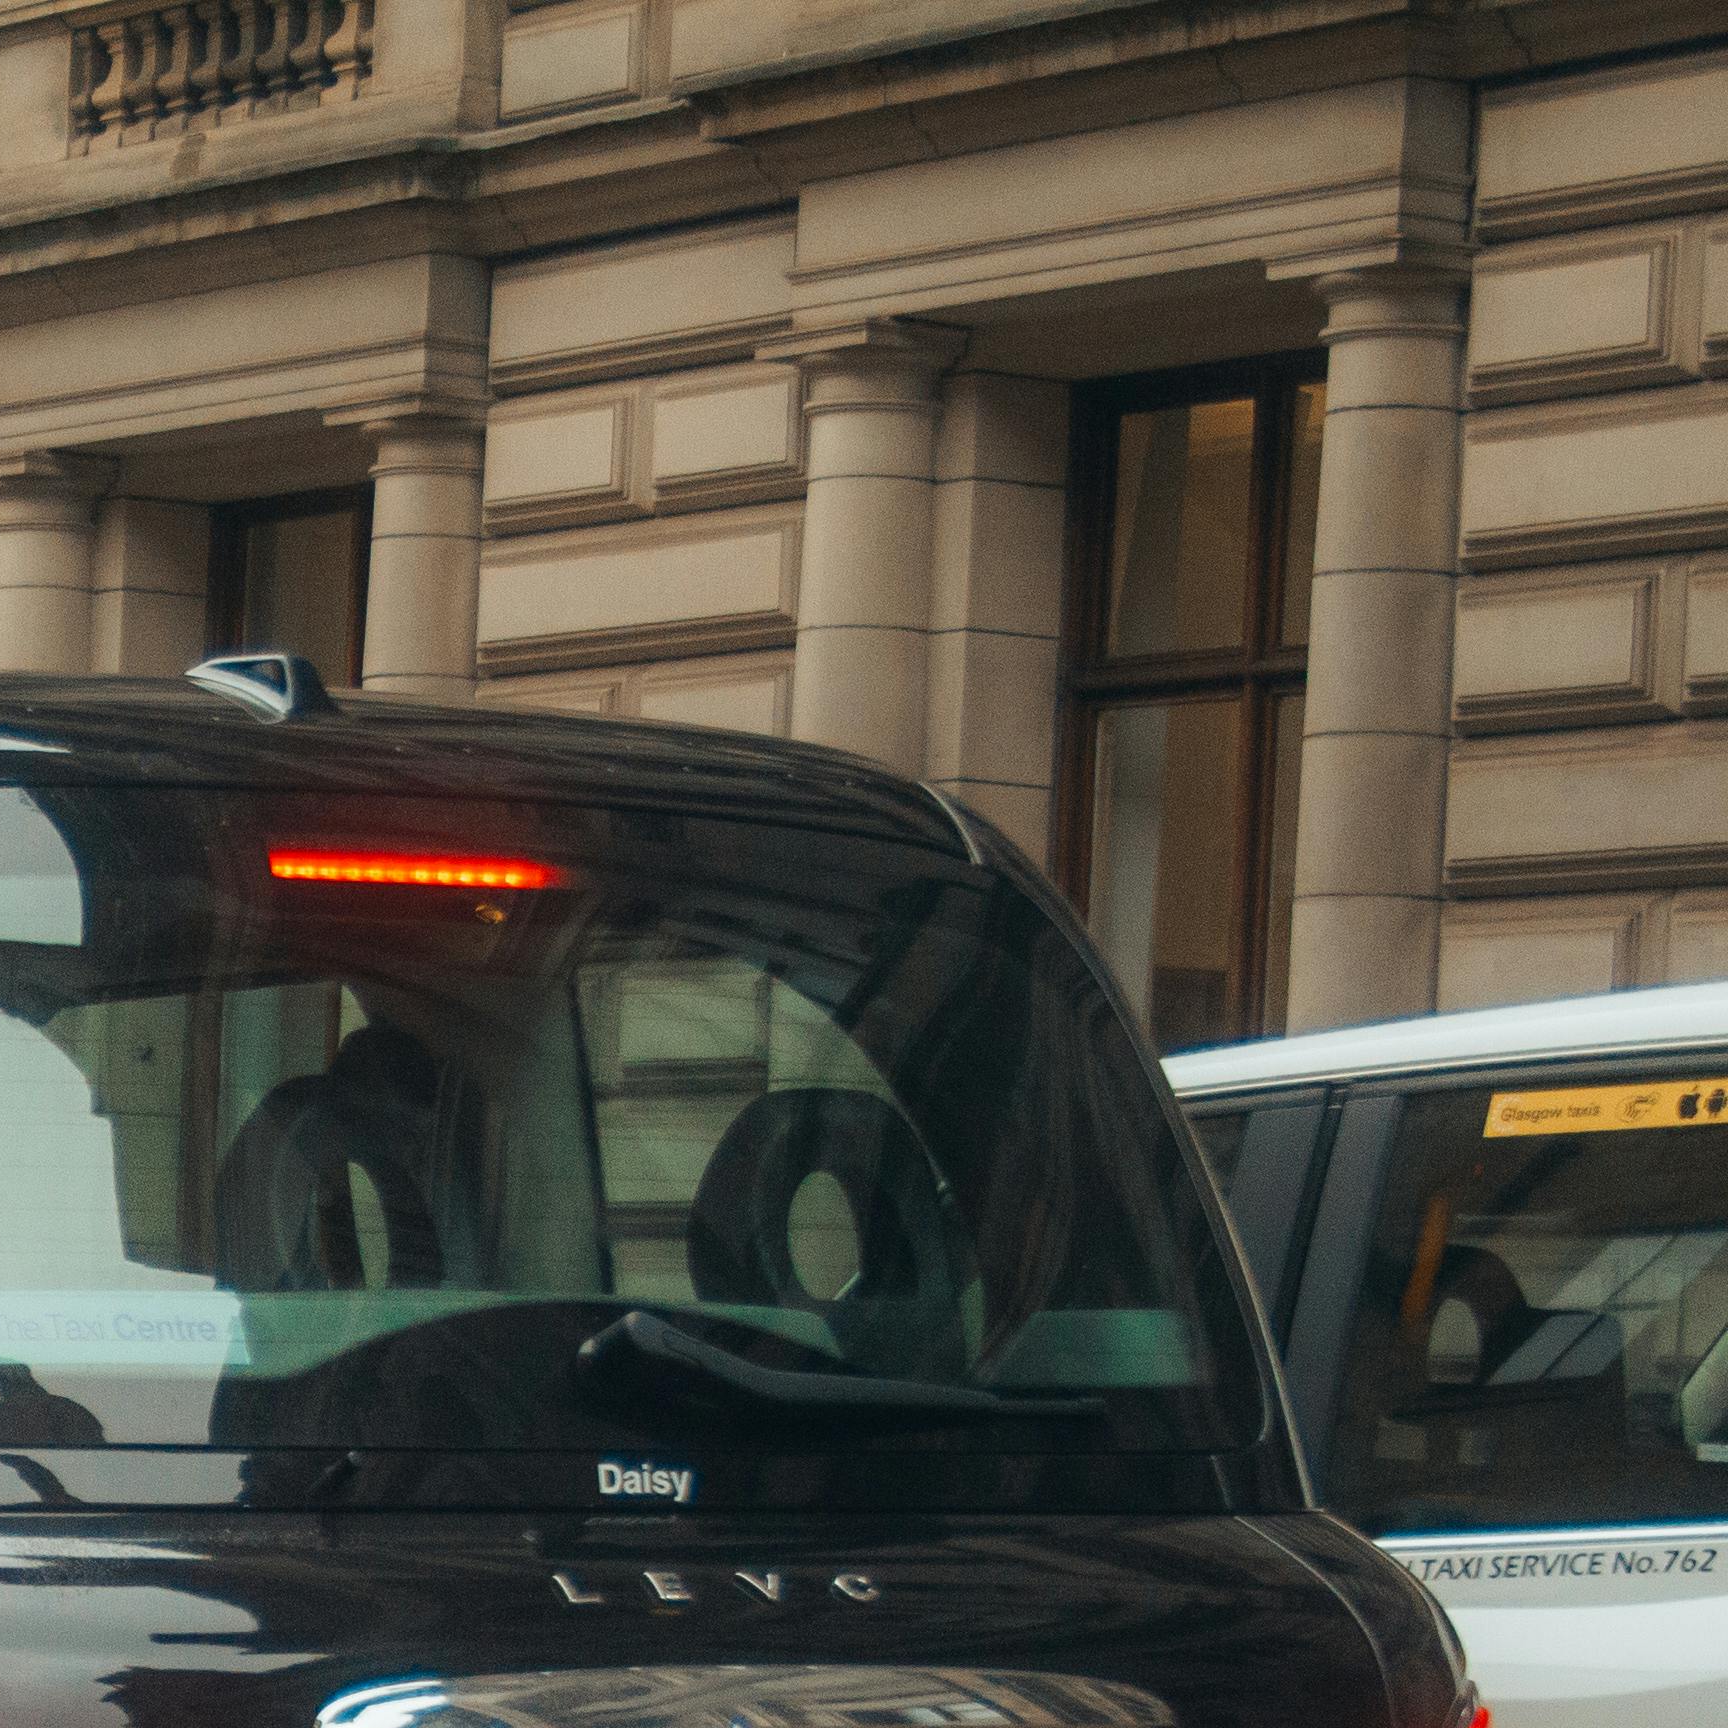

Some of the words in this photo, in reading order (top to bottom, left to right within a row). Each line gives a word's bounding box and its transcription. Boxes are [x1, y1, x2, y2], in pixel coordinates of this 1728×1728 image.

[1501, 1106, 1563, 1124] Glasgow
[44, 1314, 104, 1341] Taxi
[112, 1314, 218, 1342] Centre
[597, 1461, 692, 1502] Daisy
[1420, 1558, 1482, 1581] TAXI
[1489, 1552, 1602, 1579] SERVICE
[1612, 1548, 1718, 1575] No.762
[552, 1571, 881, 1602] LEVC
